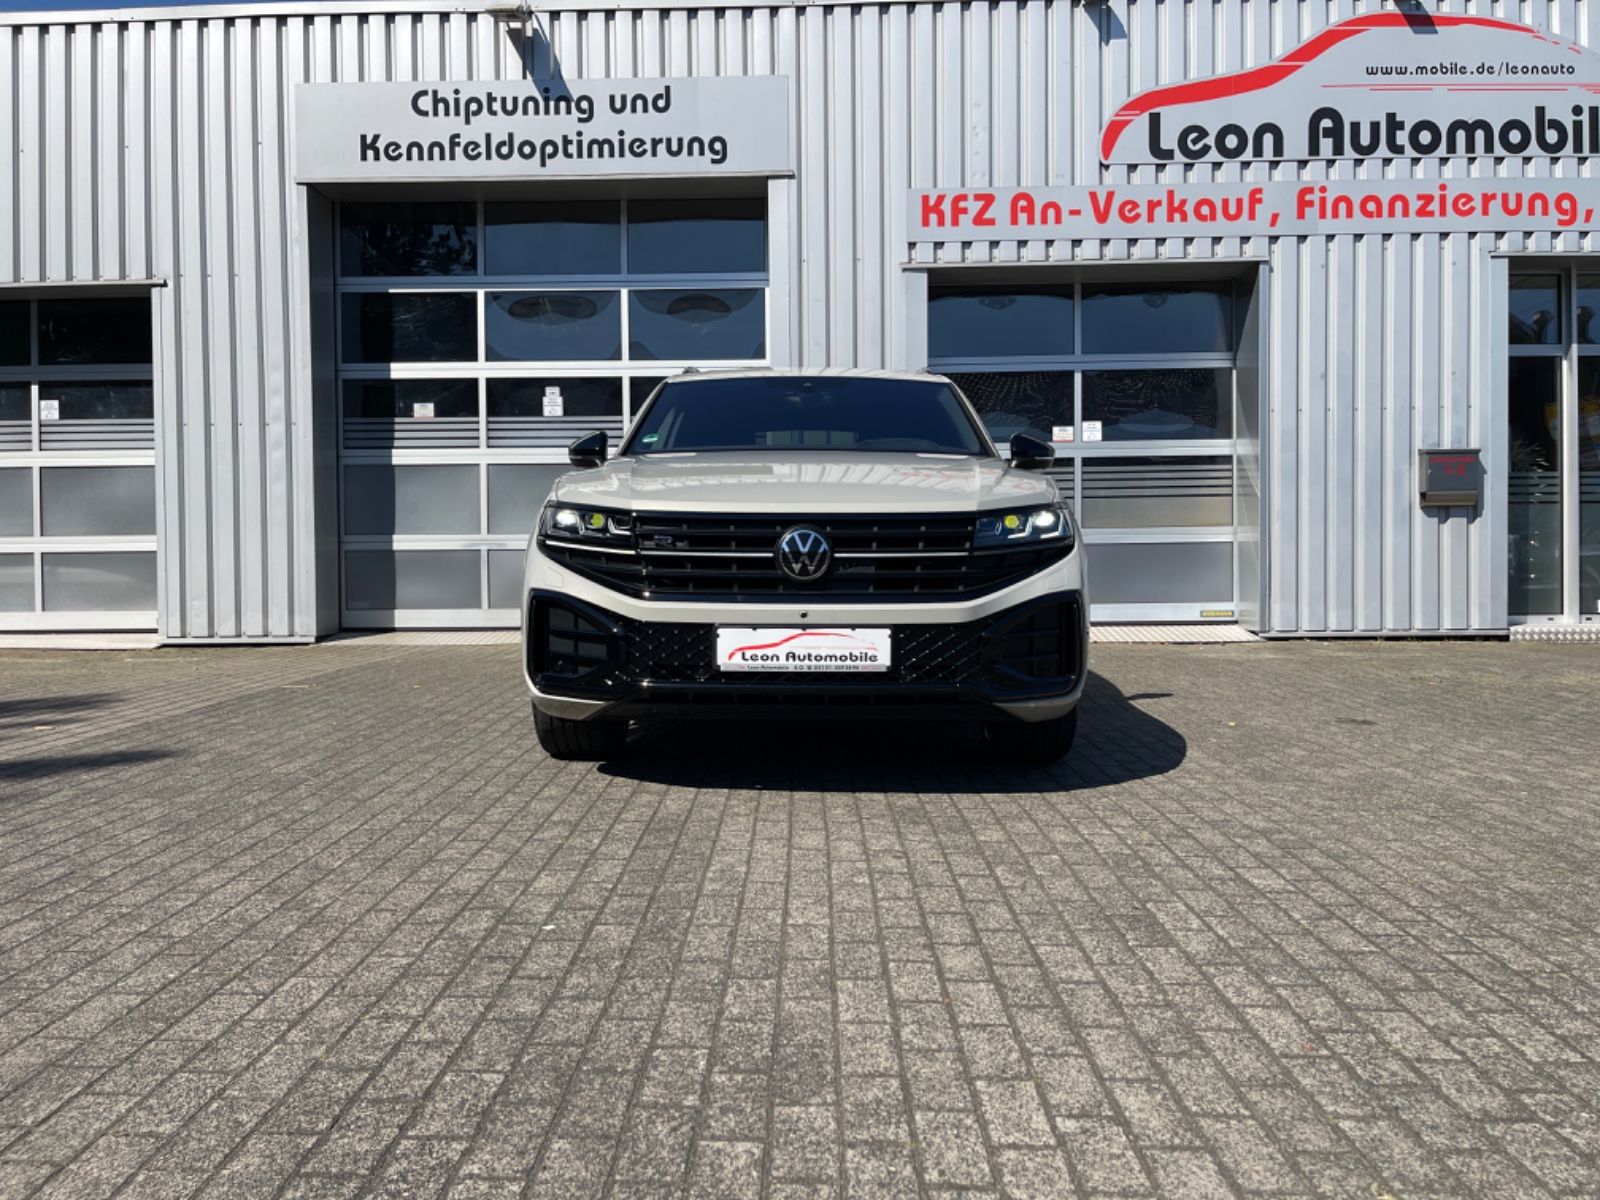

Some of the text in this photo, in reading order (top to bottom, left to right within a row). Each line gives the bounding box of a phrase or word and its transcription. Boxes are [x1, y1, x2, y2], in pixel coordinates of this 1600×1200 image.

[1366, 62, 1576, 76] www.mobile.de/leonauto
[411, 86, 671, 125] Chiptuning und
[359, 130, 728, 168] Kennfeldoptimierung
[1149, 112, 1284, 161] Leon
[1296, 183, 1594, 227] Finanzierung,
[741, 651, 879, 663] Leon Automobile
